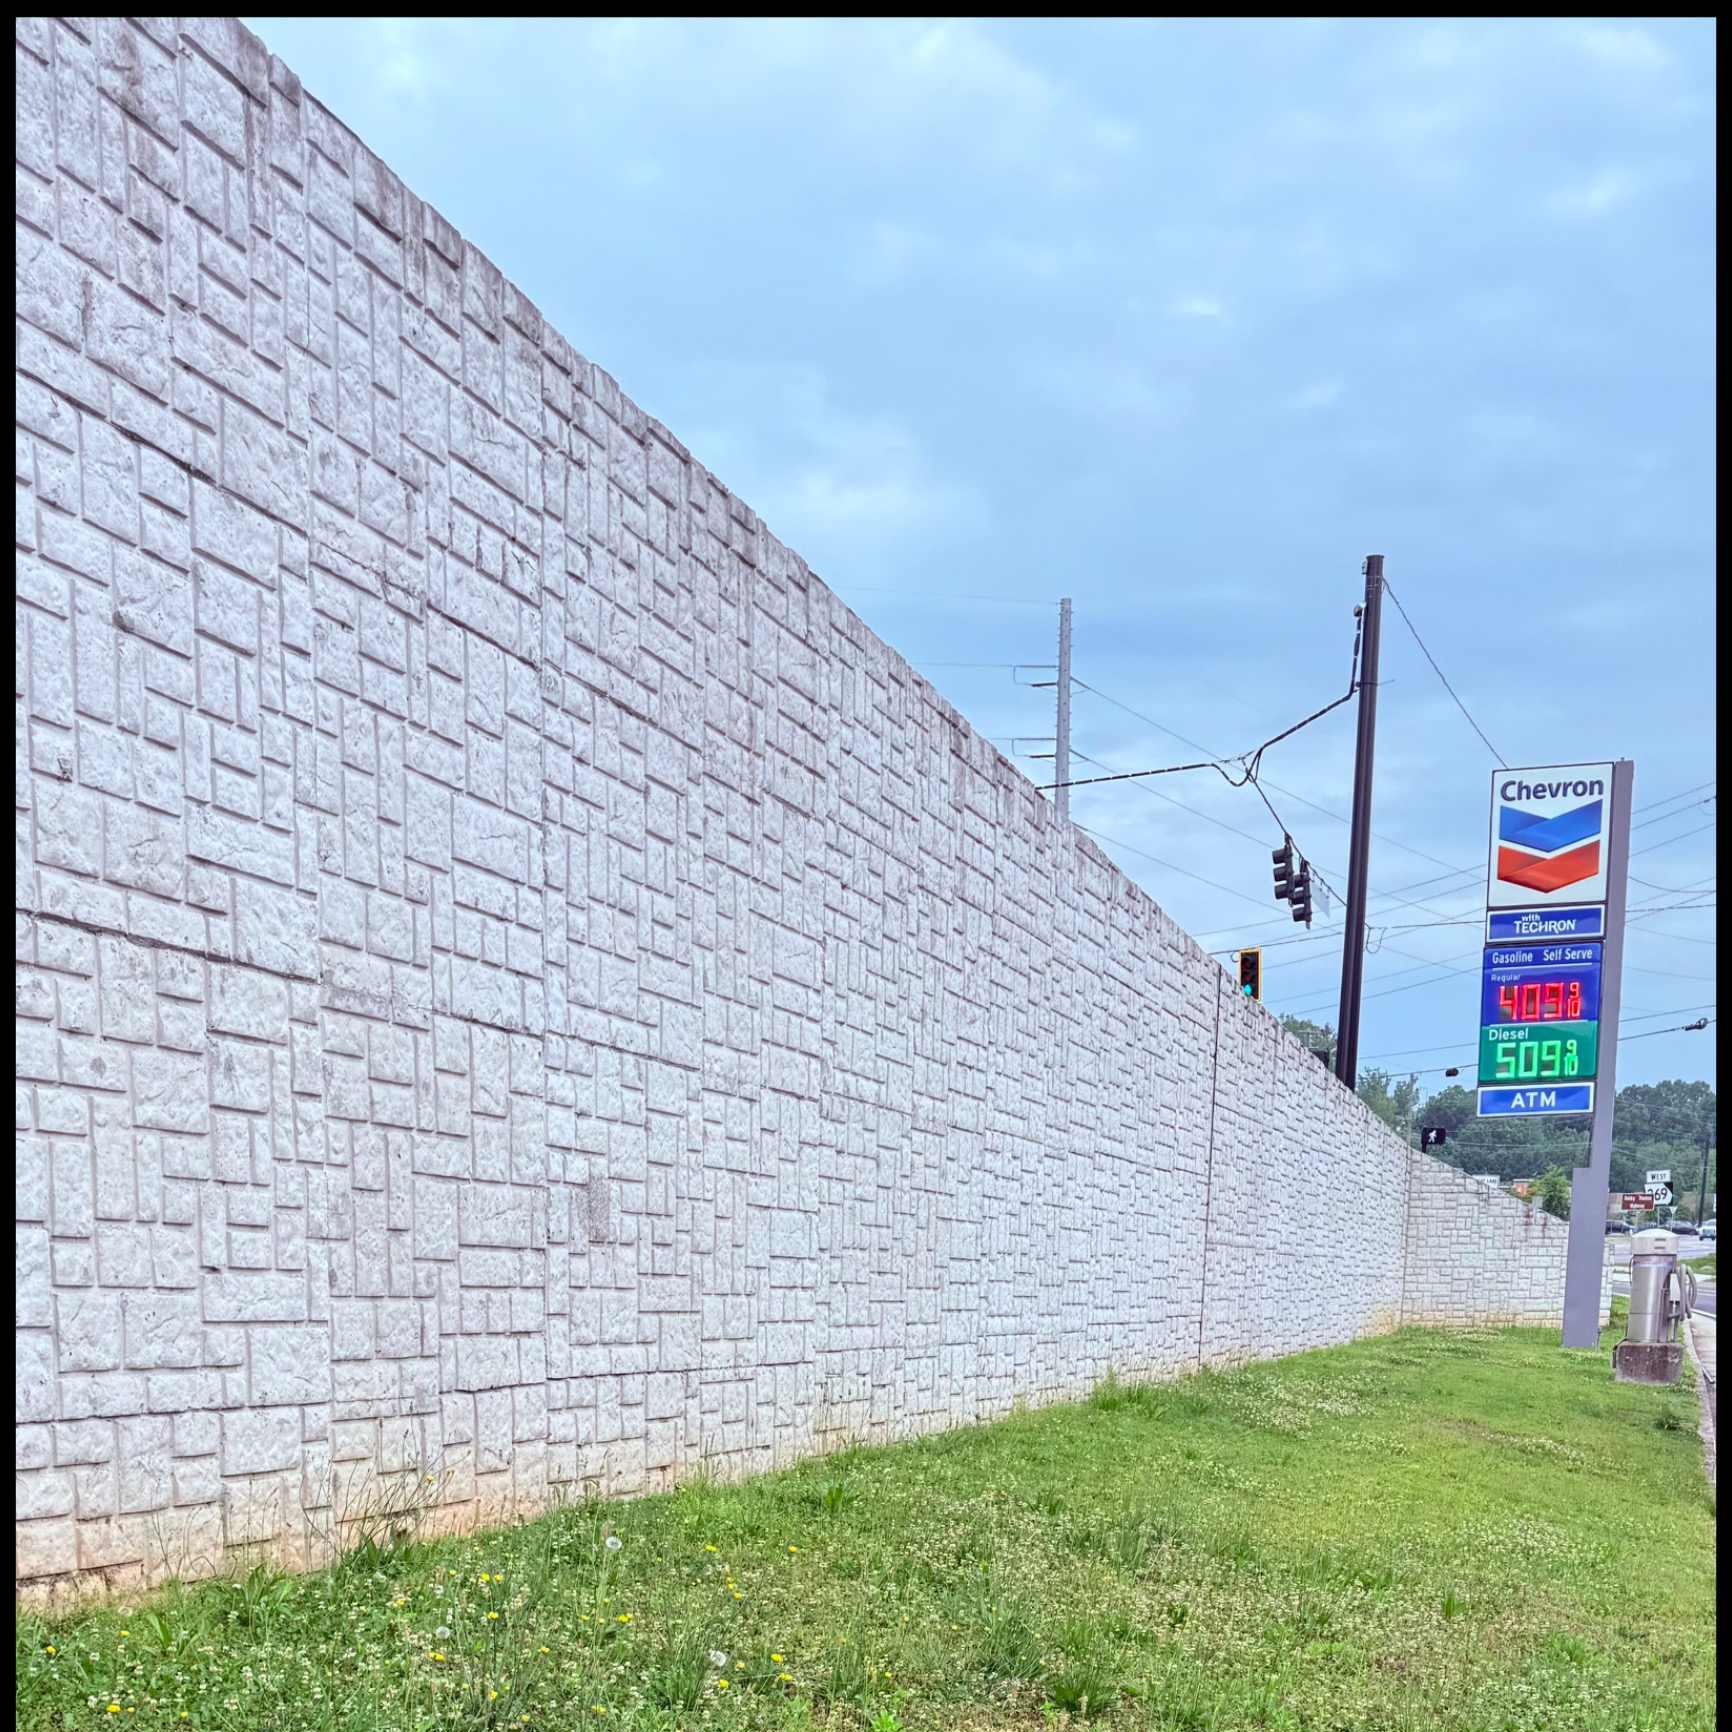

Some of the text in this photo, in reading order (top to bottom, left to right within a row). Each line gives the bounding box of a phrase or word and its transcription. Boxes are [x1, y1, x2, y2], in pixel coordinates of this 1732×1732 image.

[1500, 779, 1604, 801] Chevron
[1521, 914, 1540, 922] with
[1514, 919, 1577, 934] TECHRON
[1492, 948, 1592, 964] Gasoline Self Serve
[1491, 974, 1521, 983] Regular
[1499, 983, 1564, 1020] 409
[1488, 1027, 1528, 1041] Diesel
[1495, 1040, 1561, 1078] 509
[1510, 1091, 1556, 1109] ATM
